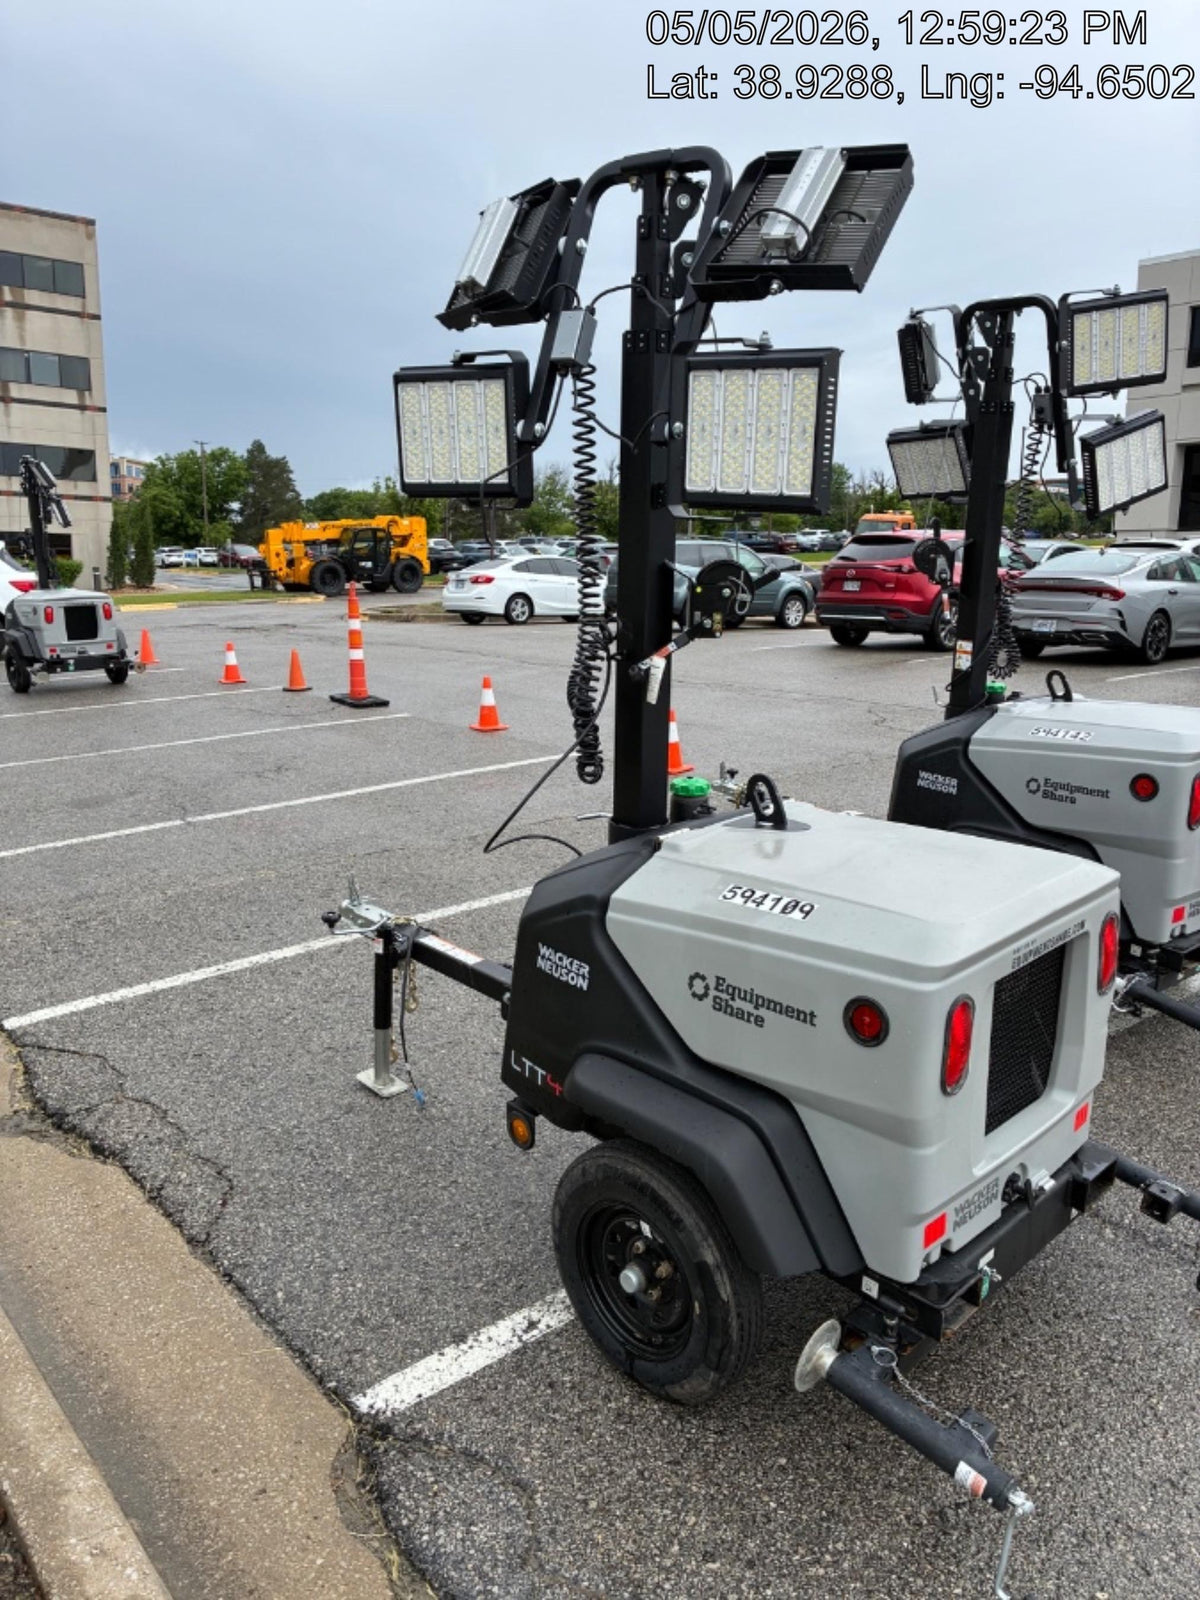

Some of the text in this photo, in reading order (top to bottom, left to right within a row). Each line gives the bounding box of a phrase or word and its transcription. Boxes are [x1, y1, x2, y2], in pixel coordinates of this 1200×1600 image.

[1041, 788, 1077, 804] Share
[1043, 777, 1110, 799] Equipment
[722, 886, 815, 920] 594109
[536, 955, 590, 991] NEUSON
[538, 941, 590, 978] WACKER
[712, 995, 765, 1028] Share
[713, 976, 817, 1027] Equipment
[511, 1049, 563, 1096] LTT4
[954, 1177, 999, 1217] WACKER
